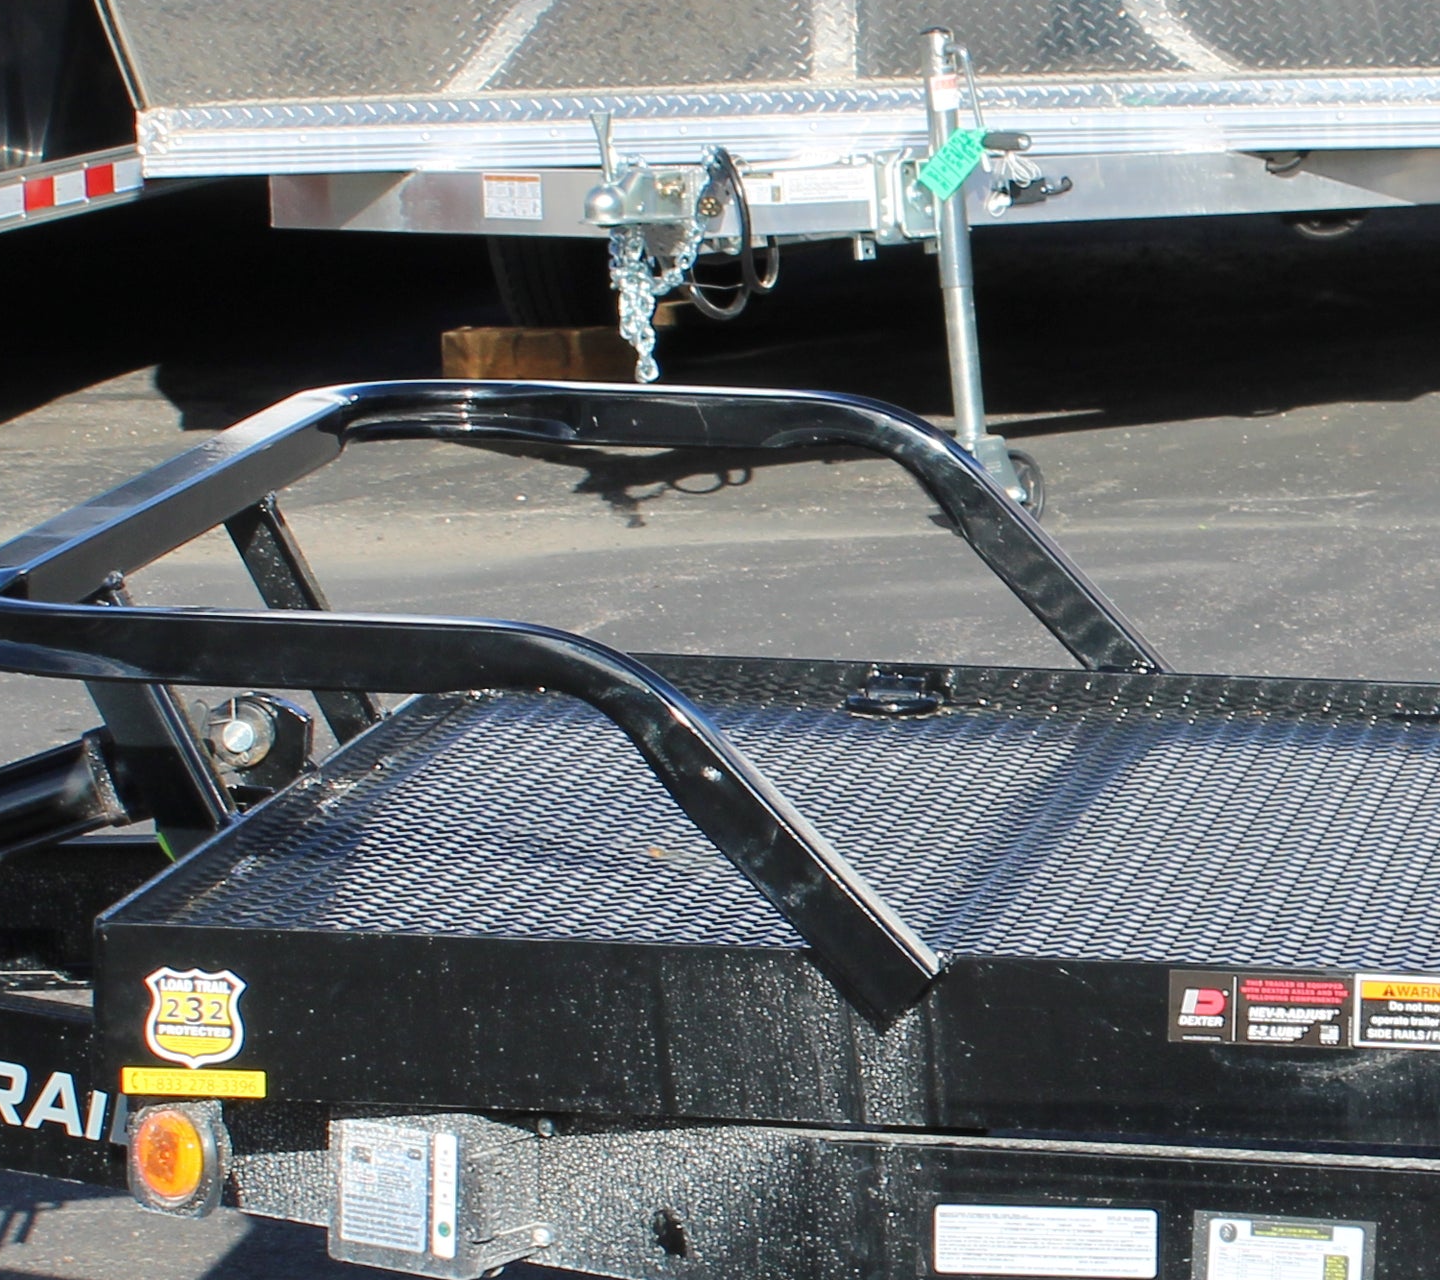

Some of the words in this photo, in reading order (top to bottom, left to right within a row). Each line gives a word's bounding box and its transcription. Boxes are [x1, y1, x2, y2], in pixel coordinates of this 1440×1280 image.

[159, 977, 193, 993] LOAD
[194, 979, 231, 995] TRAIL
[1264, 980, 1295, 988] TRAILER
[166, 997, 223, 1023] 232
[1388, 1001, 1404, 1011] Do
[1405, 1002, 1423, 1012] not
[1178, 1015, 1225, 1027] DEXTER
[1370, 1015, 1409, 1027] operate
[1410, 1016, 1440, 1027] trailer
[158, 1024, 232, 1038] PROTECTED
[1248, 1024, 1268, 1037] E-Z
[1270, 1025, 1303, 1038] LUBE
[1366, 1028, 1392, 1039] SIDE
[1394, 1029, 1425, 1041] RAILS
[143, 1077, 258, 1094] 1-833-278-3396
